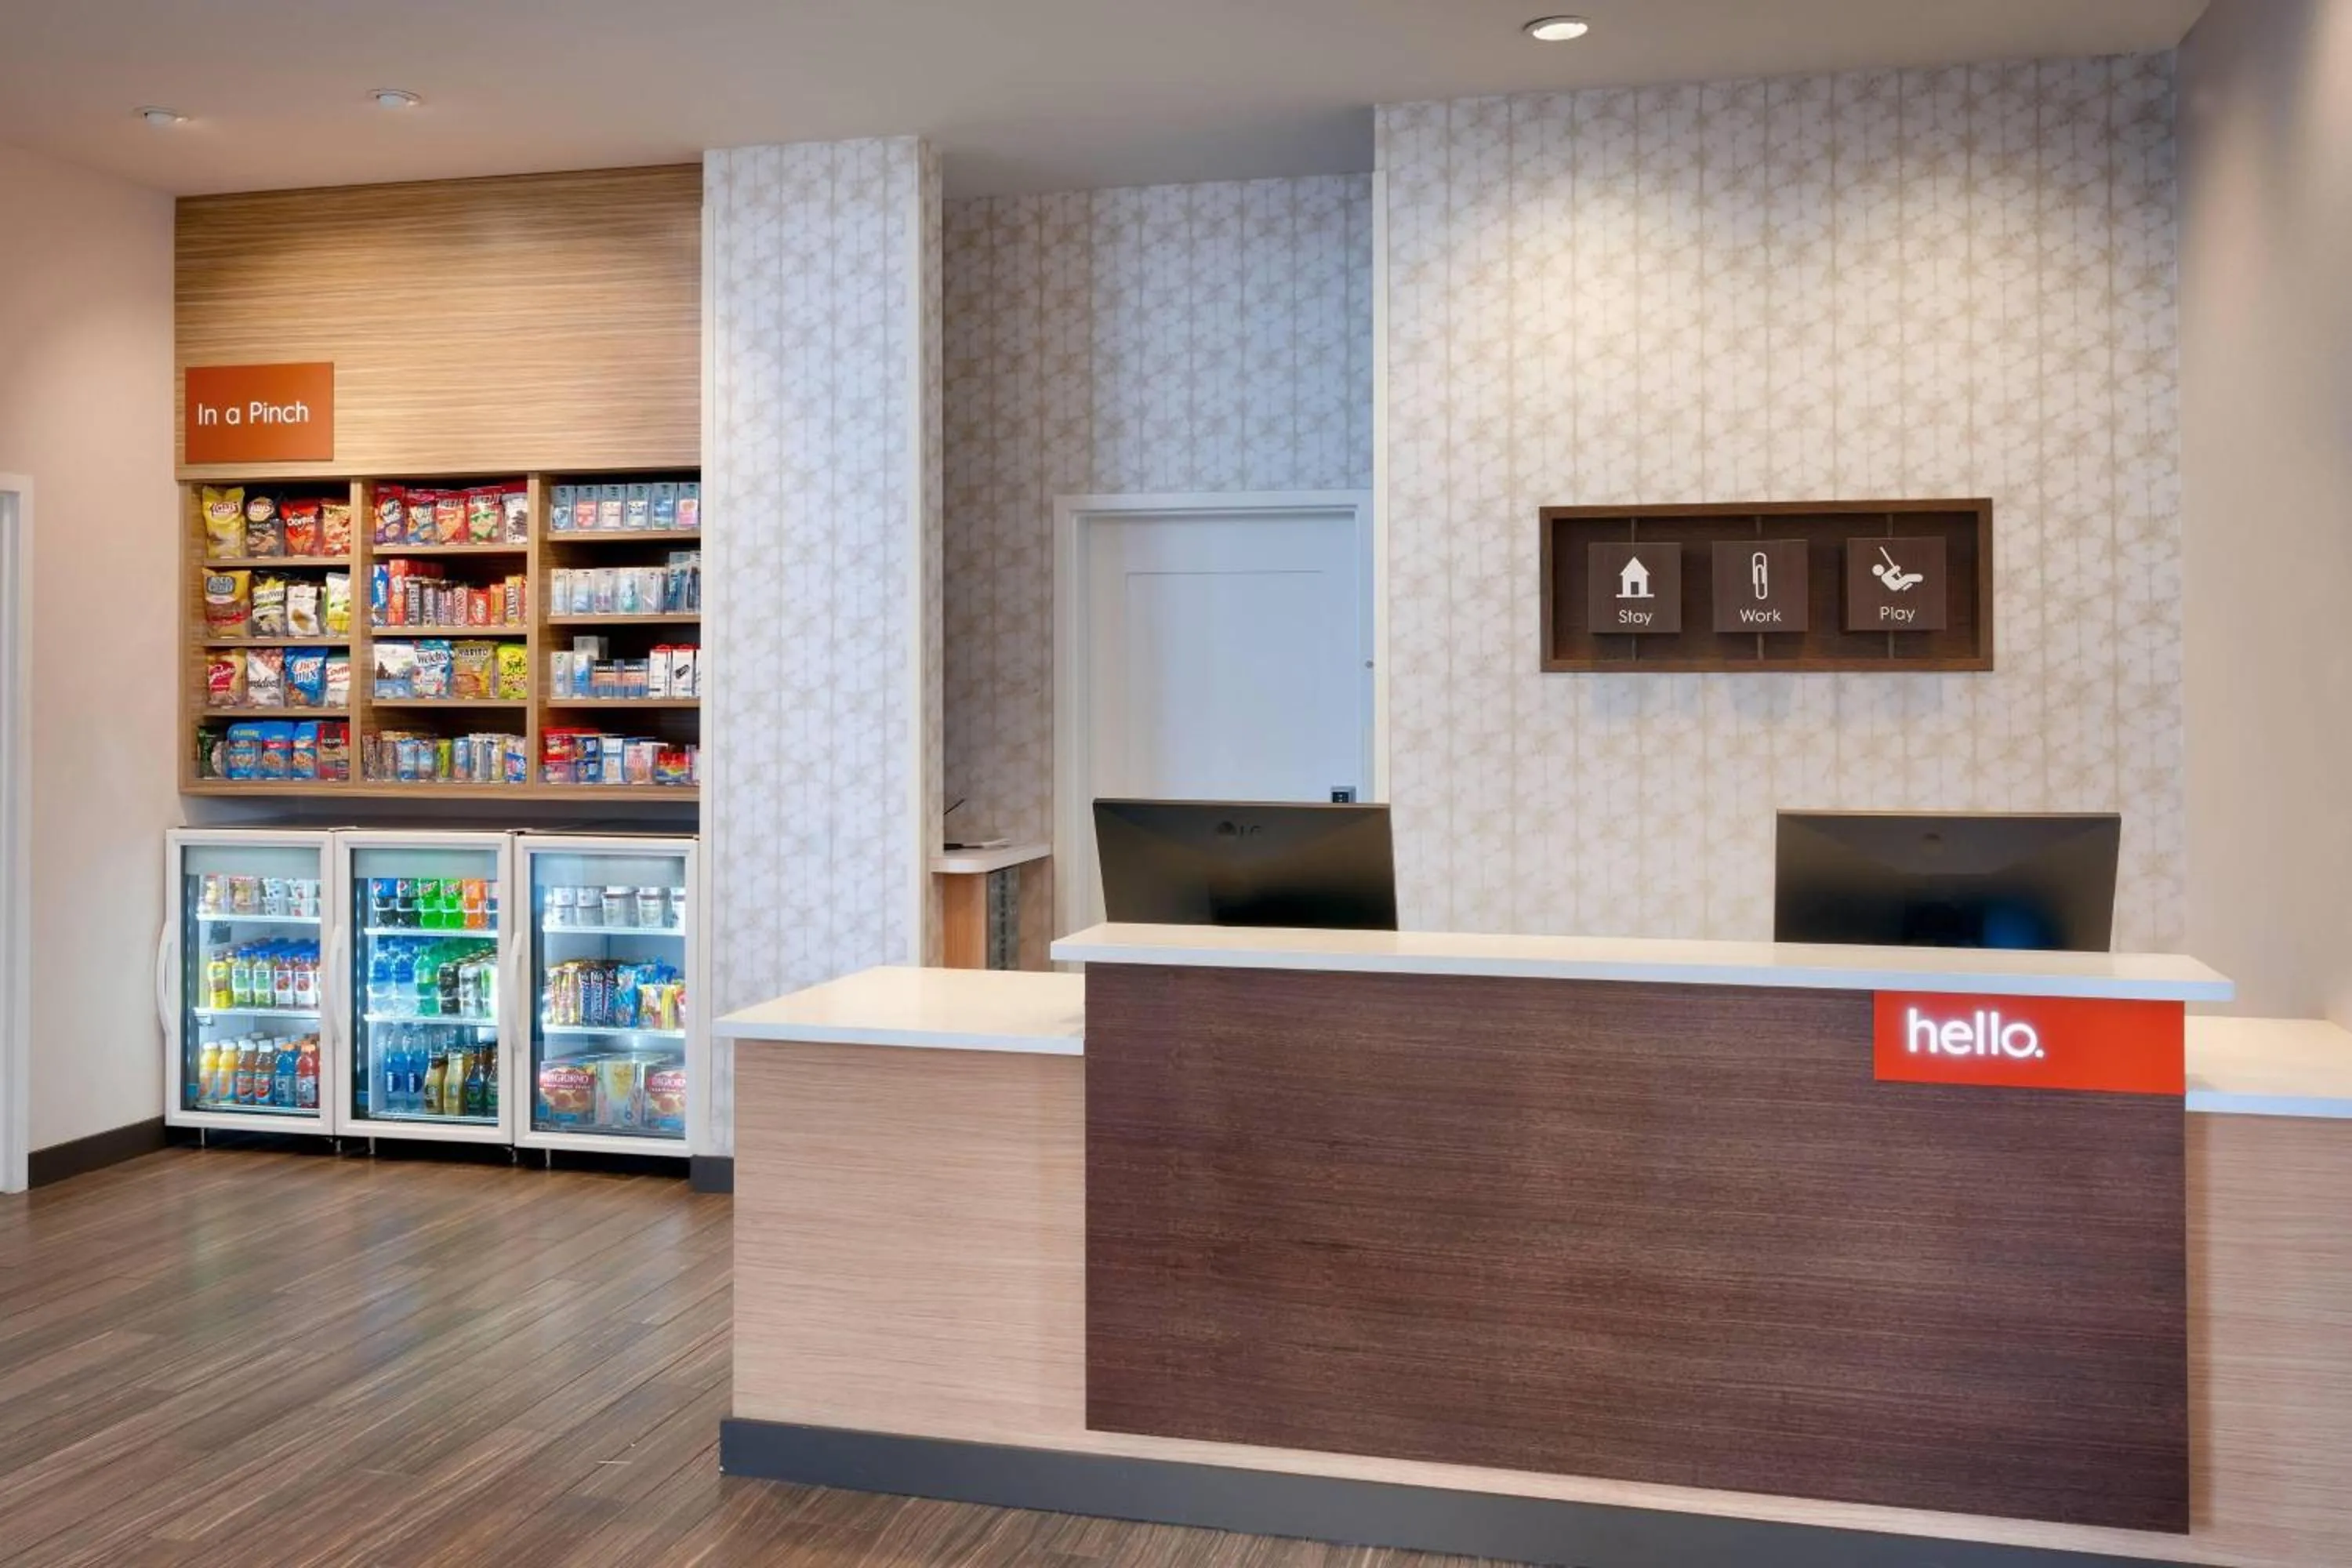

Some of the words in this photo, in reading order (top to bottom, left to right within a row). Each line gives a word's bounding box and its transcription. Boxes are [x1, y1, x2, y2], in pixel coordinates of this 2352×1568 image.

[198, 402, 218, 426] In
[225, 406, 241, 425] a
[249, 401, 310, 424] Pinch
[1617, 609, 1653, 626] Stay
[1740, 608, 1782, 622] Work
[1880, 606, 1915, 623] Play
[1907, 1007, 2045, 1058] hello.
